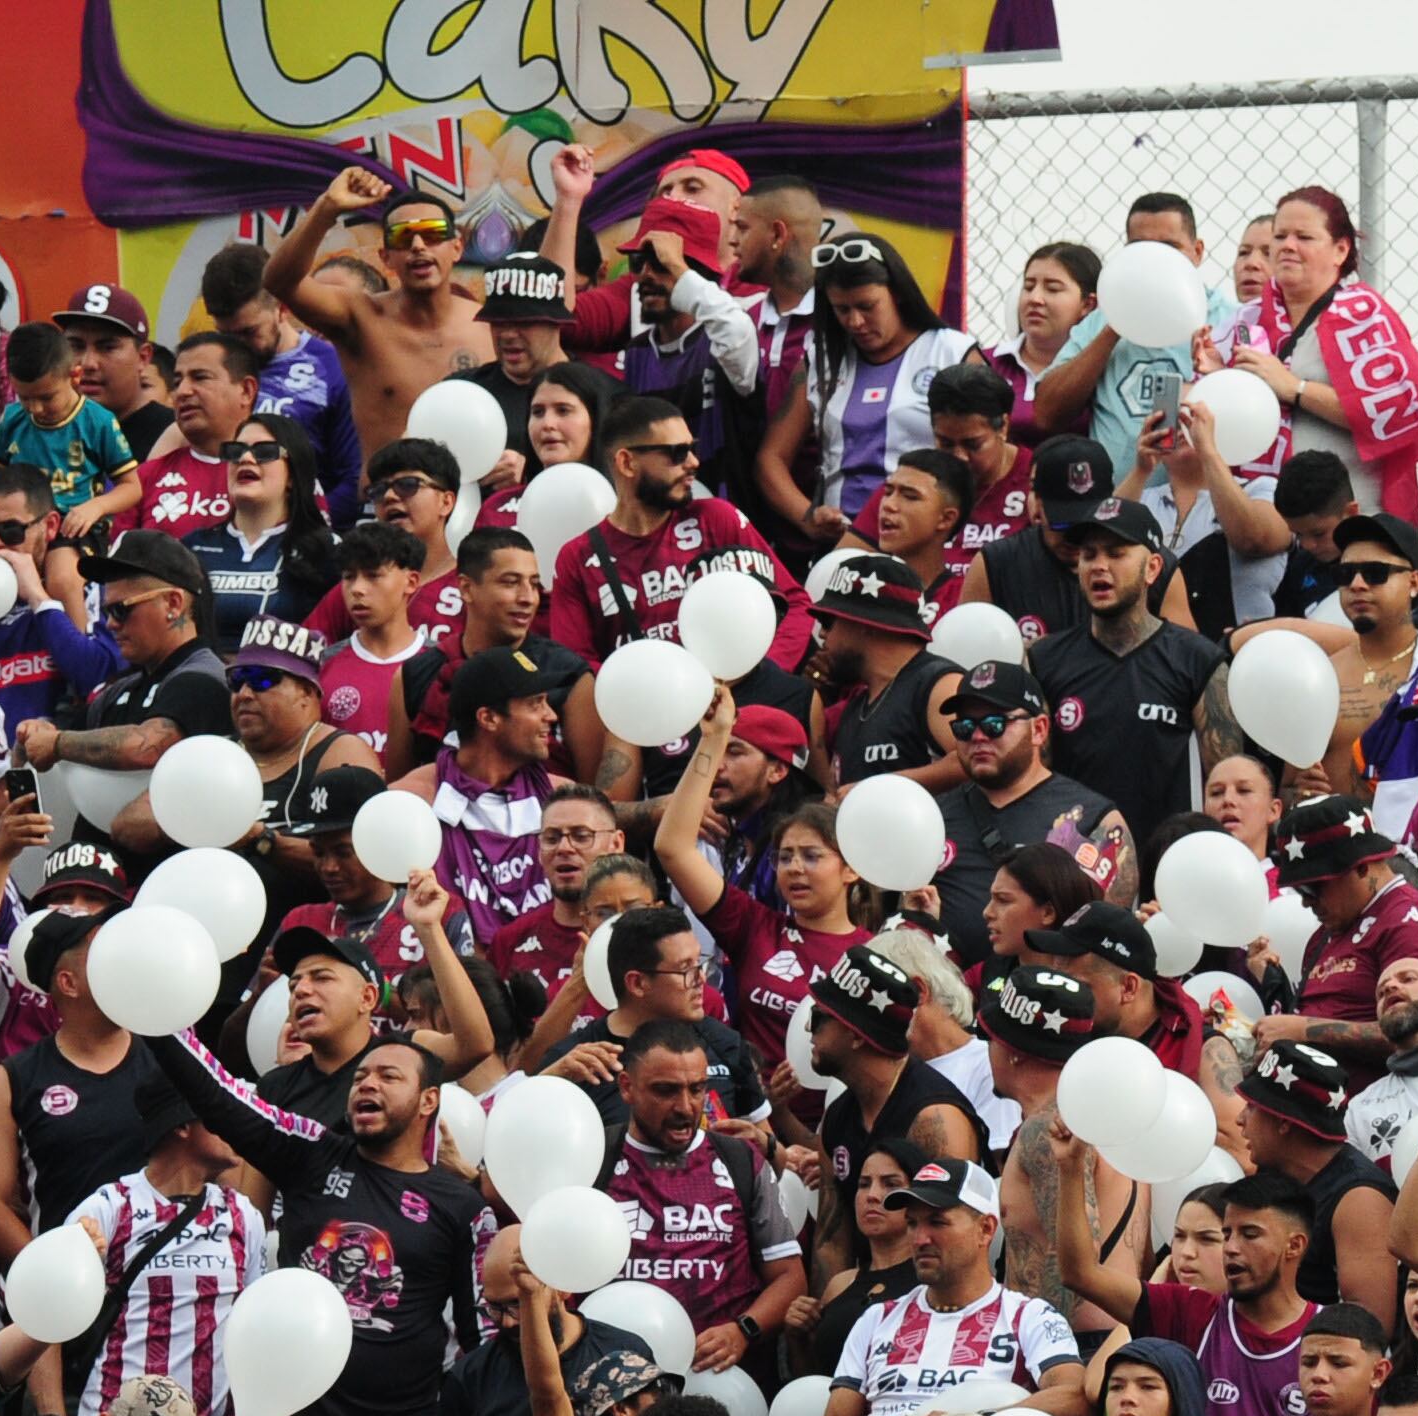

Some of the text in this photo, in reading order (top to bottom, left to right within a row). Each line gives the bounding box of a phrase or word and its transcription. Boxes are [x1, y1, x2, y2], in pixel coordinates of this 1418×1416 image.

[84, 285, 111, 314] S
[284, 363, 314, 389] S
[674, 518, 702, 551] S
[964, 522, 1010, 545] BAC
[663, 1205, 735, 1233] BAC
[664, 1231, 734, 1244] CREDOMATIC
[917, 1368, 979, 1387] BAC
